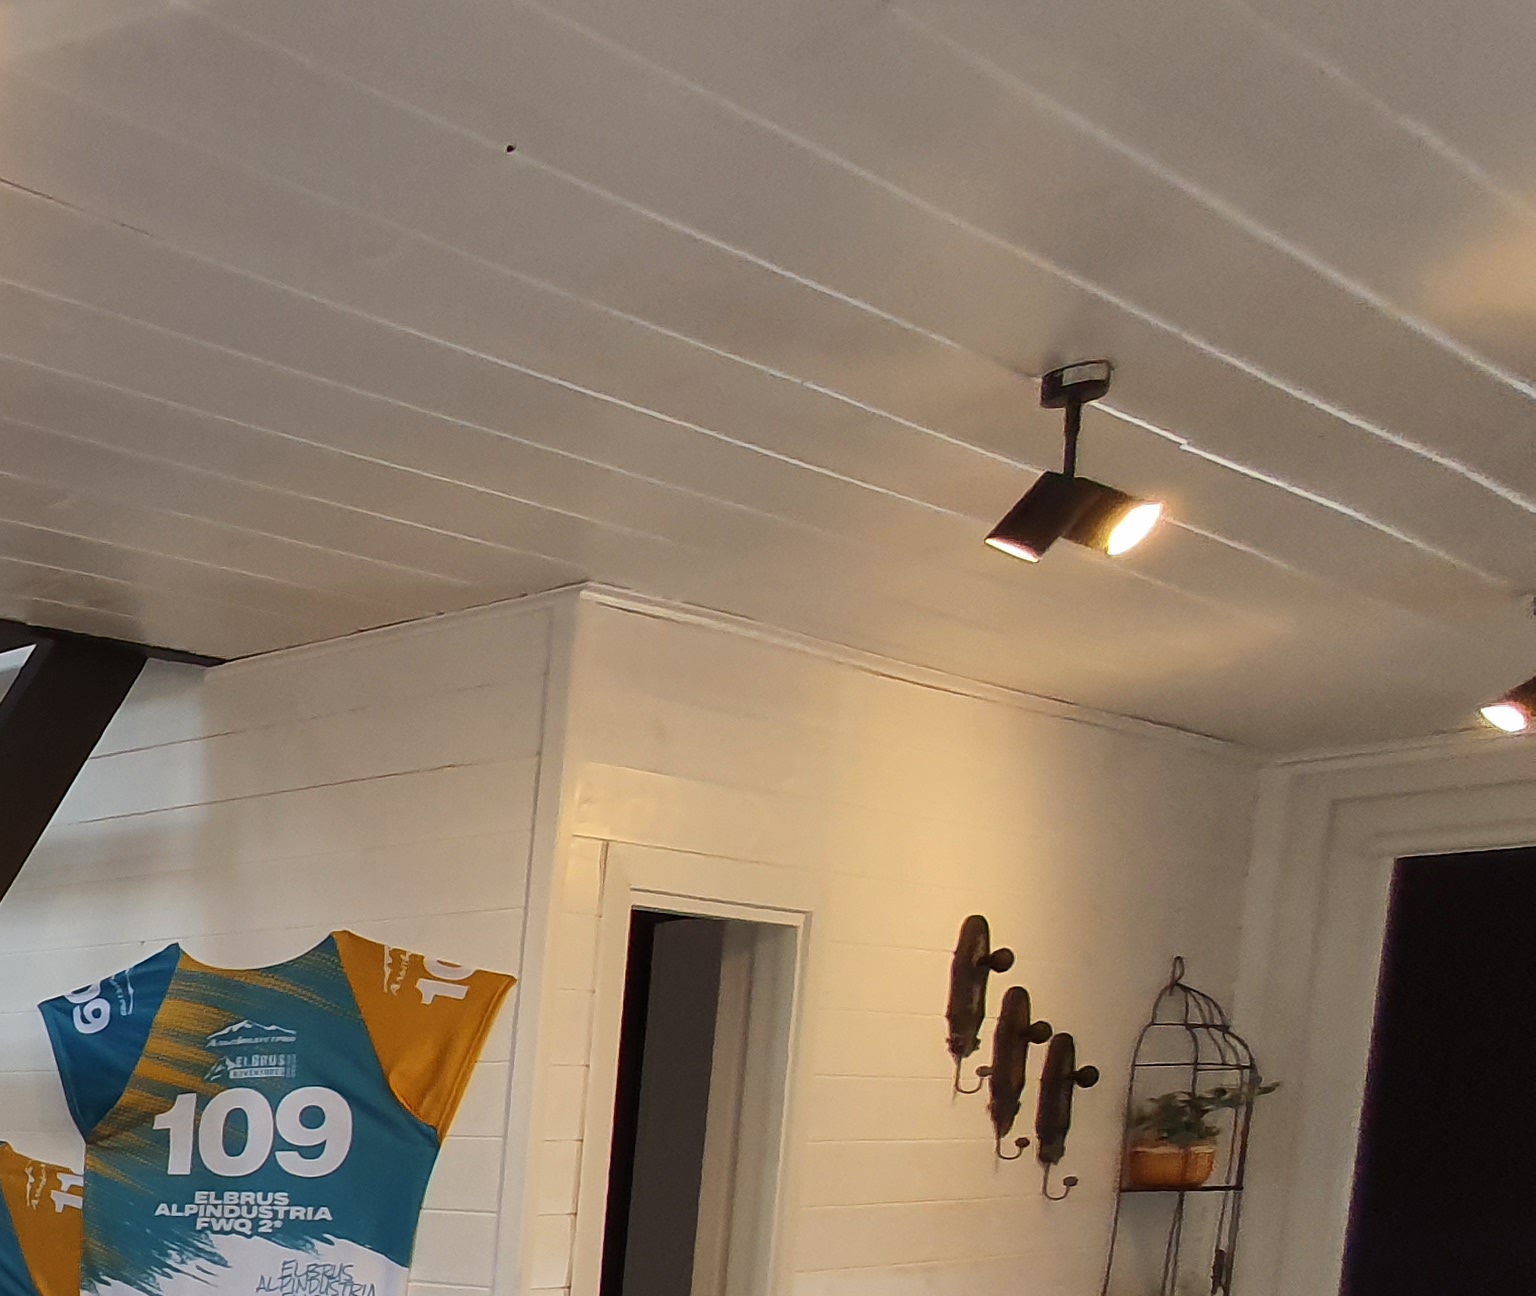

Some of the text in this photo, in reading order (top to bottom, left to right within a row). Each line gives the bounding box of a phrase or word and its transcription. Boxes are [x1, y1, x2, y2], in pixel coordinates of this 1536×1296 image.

[152, 1086, 354, 1179] 109
[194, 1191, 290, 1206] ELBRUS
[154, 1203, 333, 1221] ALPINDUSTRIA
[195, 1218, 252, 1235] FWQ
[278, 1259, 354, 1281] ELBRUS
